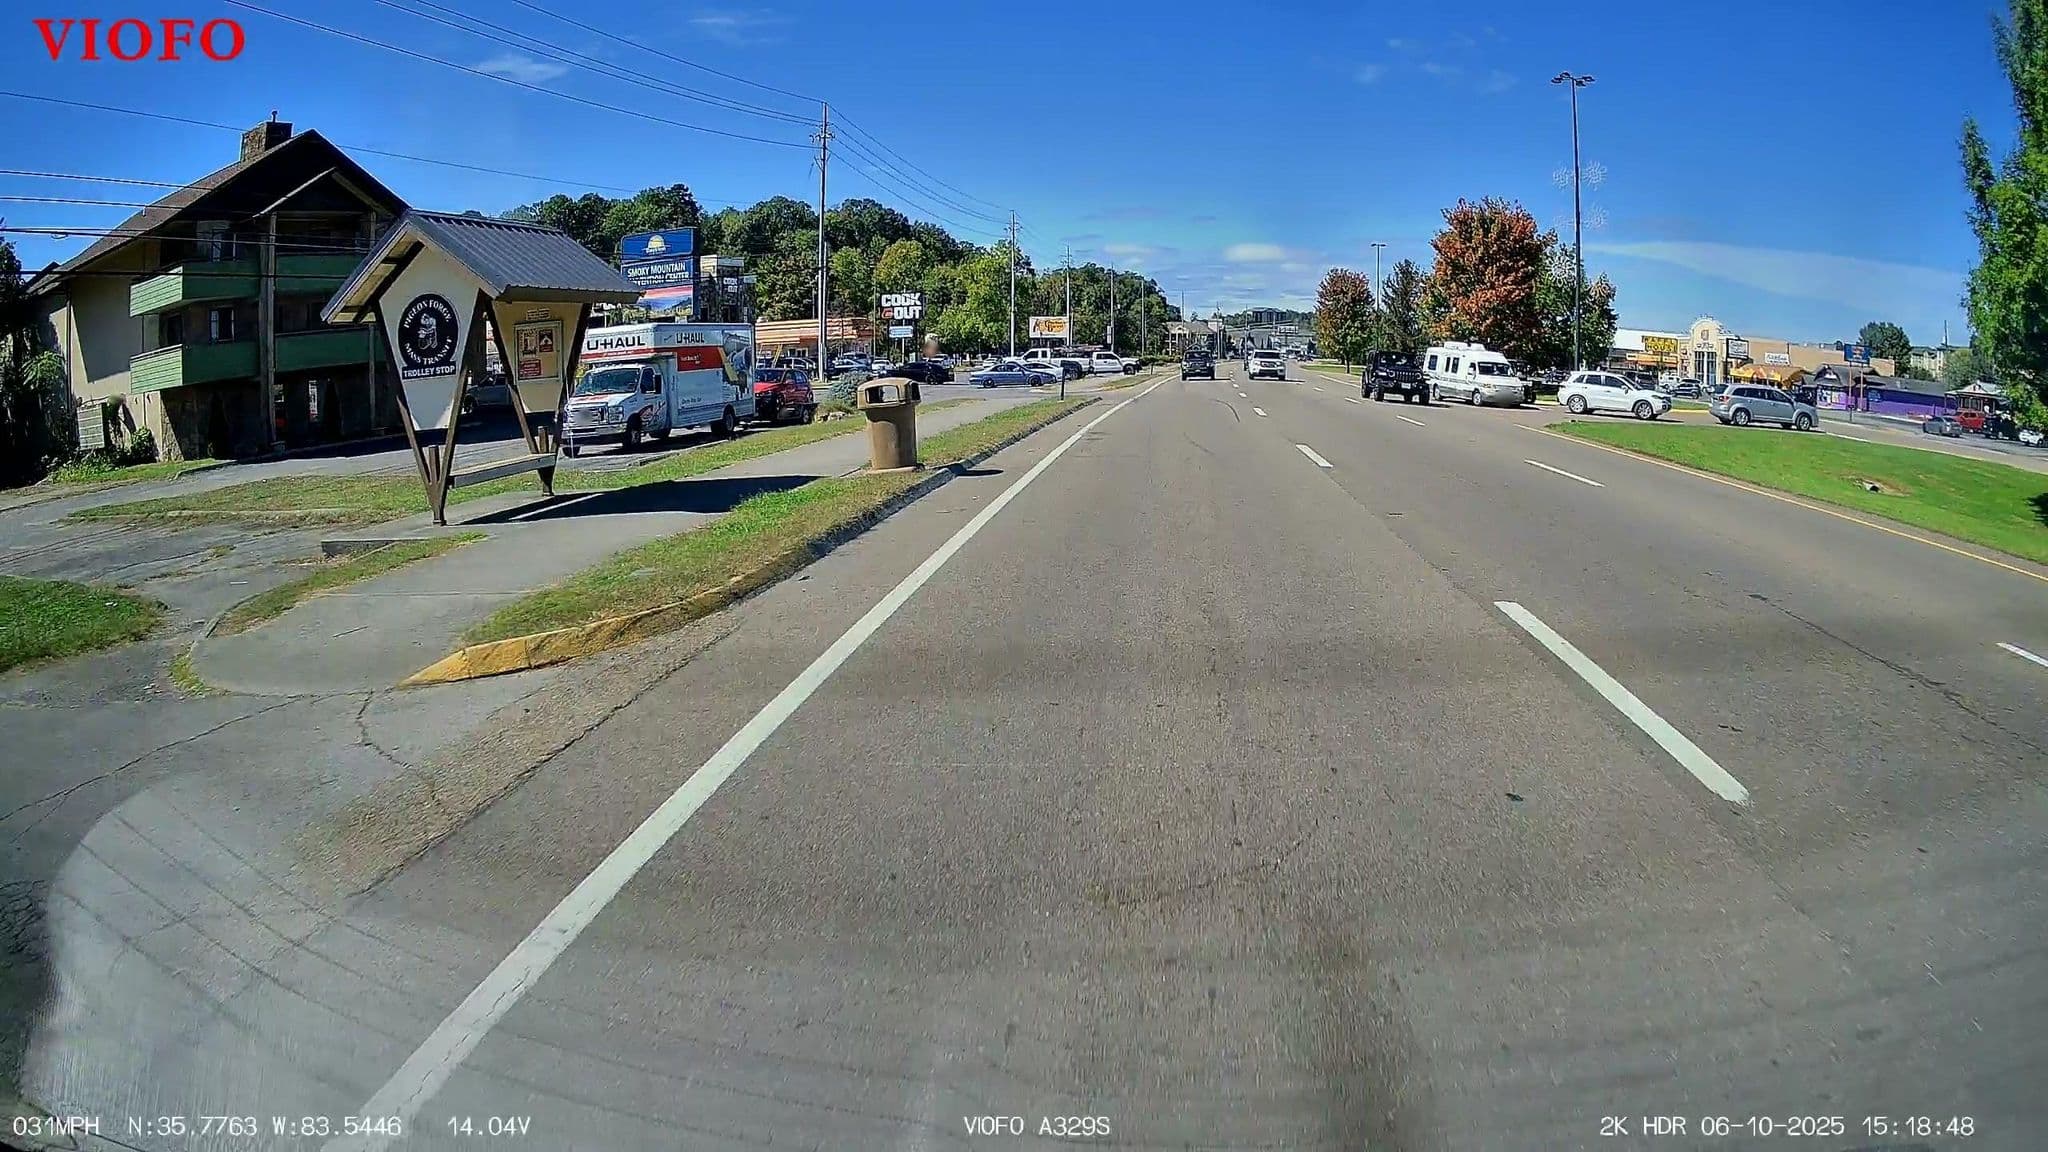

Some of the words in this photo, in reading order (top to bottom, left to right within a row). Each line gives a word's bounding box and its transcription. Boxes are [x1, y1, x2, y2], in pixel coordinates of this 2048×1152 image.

[627, 267, 650, 278] SMOKY
[650, 262, 687, 275] MOUNTAIN
[881, 293, 922, 307] COOK
[403, 301, 428, 329] PIGEON
[429, 299, 453, 322] FORGE
[894, 306, 922, 320] OUT
[587, 335, 646, 350] U-HAUL
[676, 332, 705, 344] U-HAUL
[404, 342, 421, 363] MASS
[423, 335, 453, 365] TRANSIT
[403, 367, 435, 378] TROLLEY
[435, 365, 456, 374] STOP
